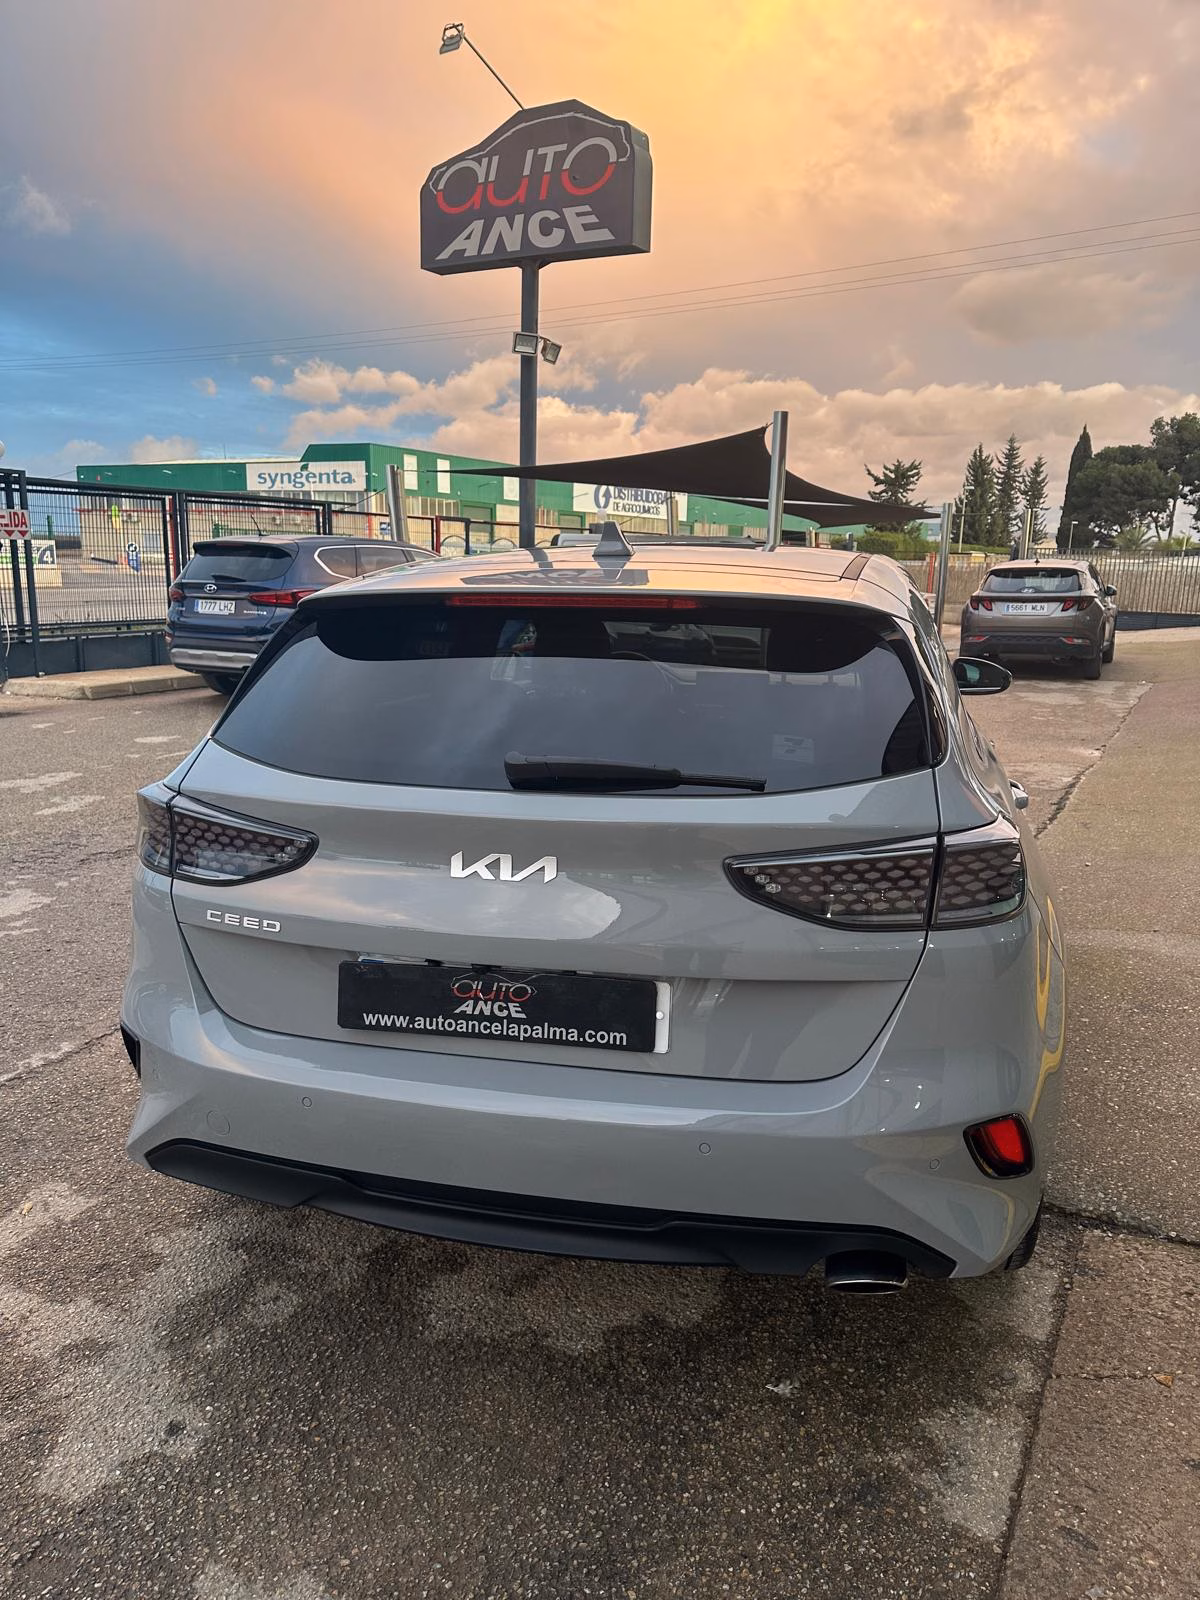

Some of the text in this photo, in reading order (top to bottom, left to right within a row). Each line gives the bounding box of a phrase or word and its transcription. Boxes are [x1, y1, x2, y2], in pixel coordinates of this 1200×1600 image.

[435, 205, 616, 260] ANCE
[257, 469, 353, 488] syngenta
[200, 601, 234, 612] 1777 LHZ
[450, 851, 558, 884] KIA
[206, 909, 282, 933] CEED
[454, 1000, 527, 1019] ANCE
[362, 1012, 628, 1046] www.autoancelapalma.com
